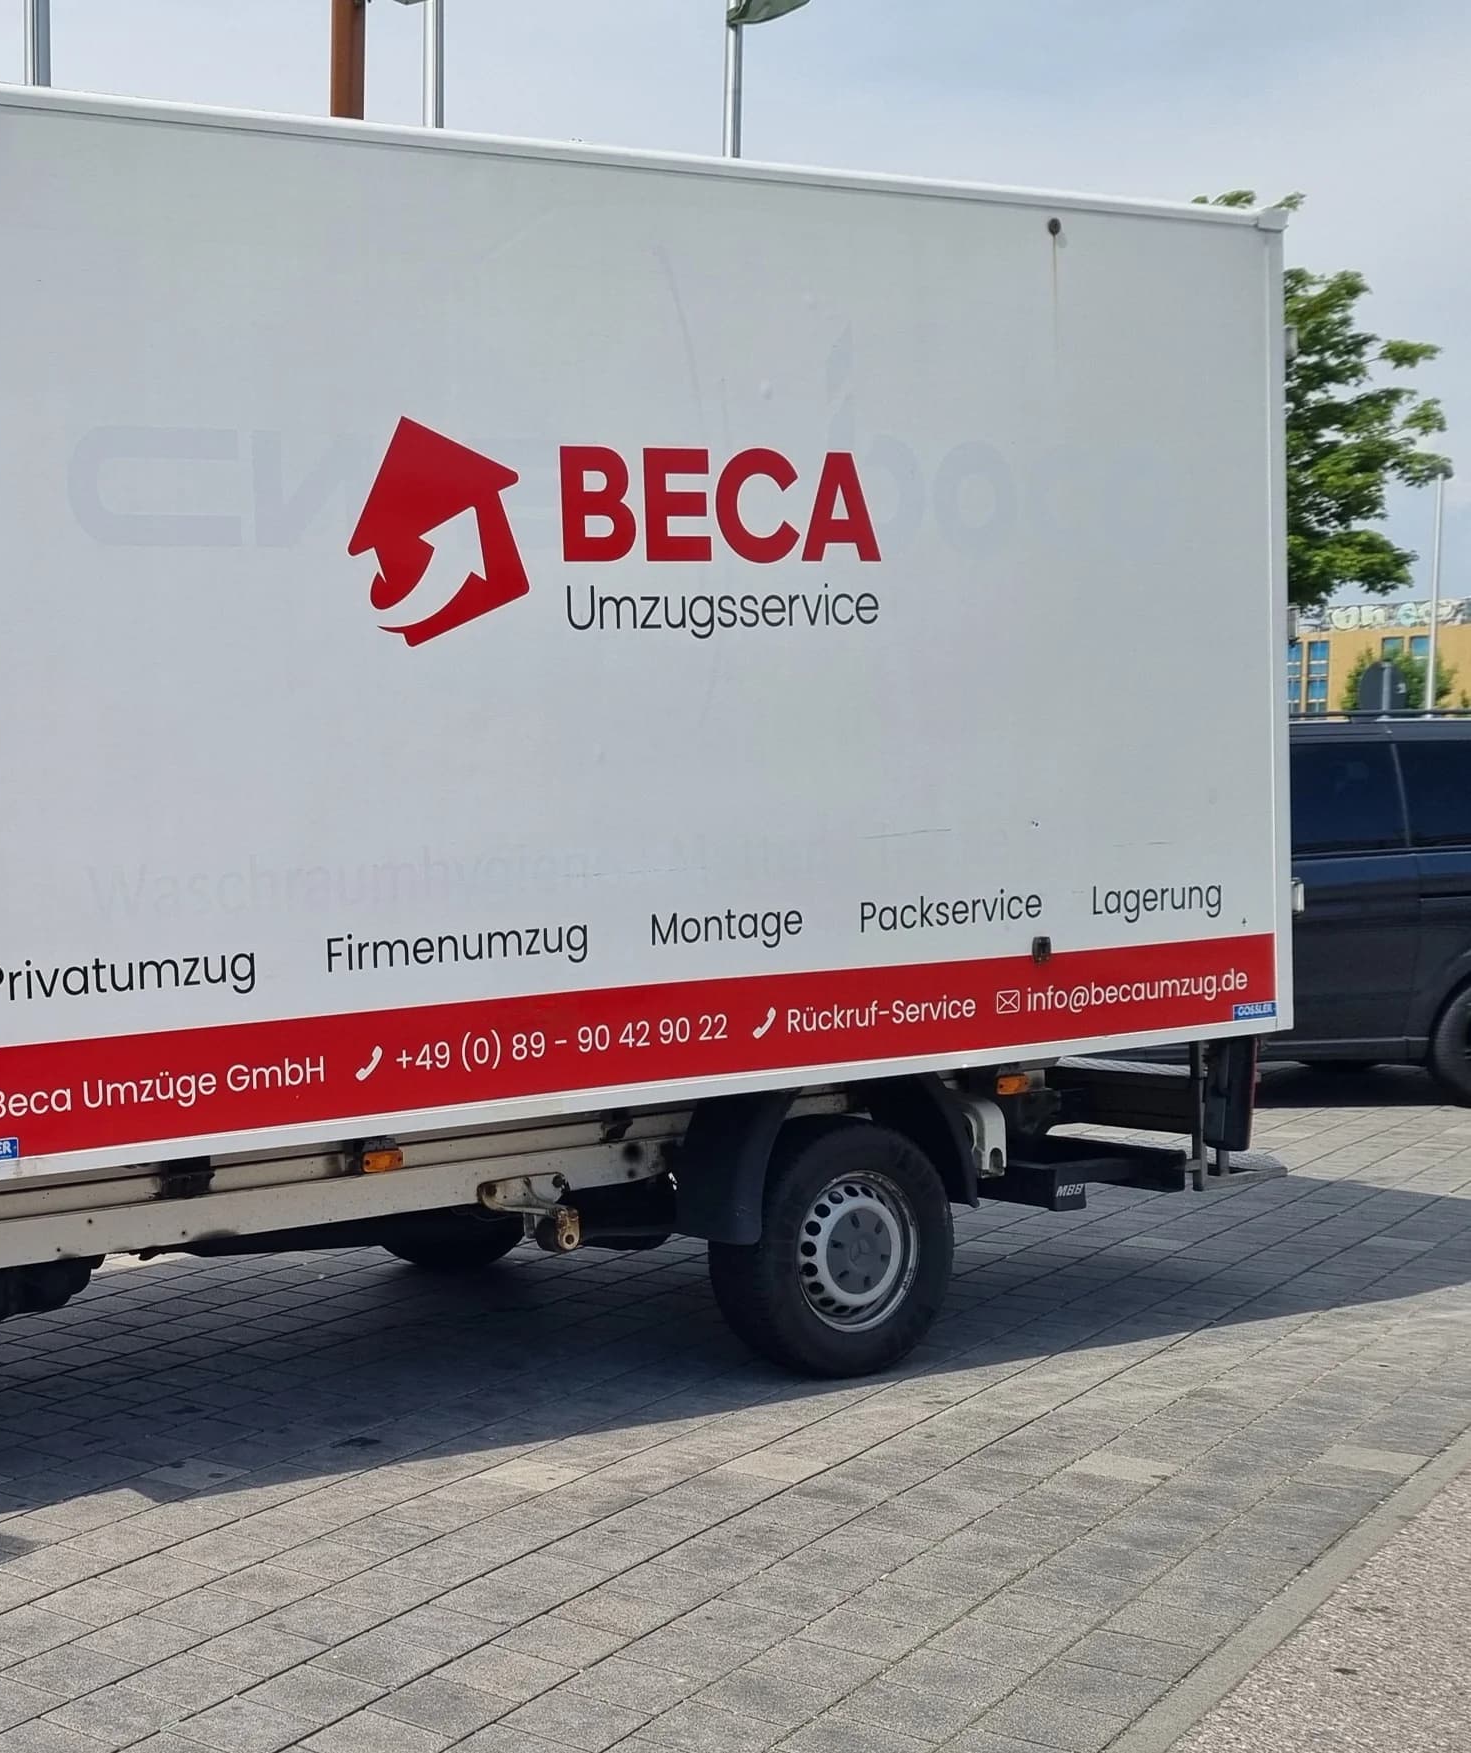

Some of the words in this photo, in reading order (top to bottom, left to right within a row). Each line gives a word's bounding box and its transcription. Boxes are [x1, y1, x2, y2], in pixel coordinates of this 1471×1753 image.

[560, 445, 881, 563] BECA
[566, 583, 879, 639] Umzugsservice
[326, 921, 589, 973] Firmenumzug
[651, 907, 803, 949] Montage
[860, 888, 1042, 933] Packservice
[1092, 881, 1223, 924] Lagerung
[787, 994, 976, 1034] Rückruf-Service
[1027, 968, 1248, 1013] info@becaumzug.de
[1237, 1003, 1273, 1016] GOSSLER
[396, 1041, 450, 1070] +49
[461, 1029, 501, 1072] (0)
[512, 1031, 546, 1061] 89
[577, 1024, 610, 1054] 90
[619, 1020, 651, 1048] 42
[659, 1016, 690, 1045] 90
[698, 1013, 728, 1041] 22
[83, 1070, 217, 1108] Umzüge
[227, 1055, 325, 1092] GmbH
[1055, 1184, 1084, 1197] MBB
